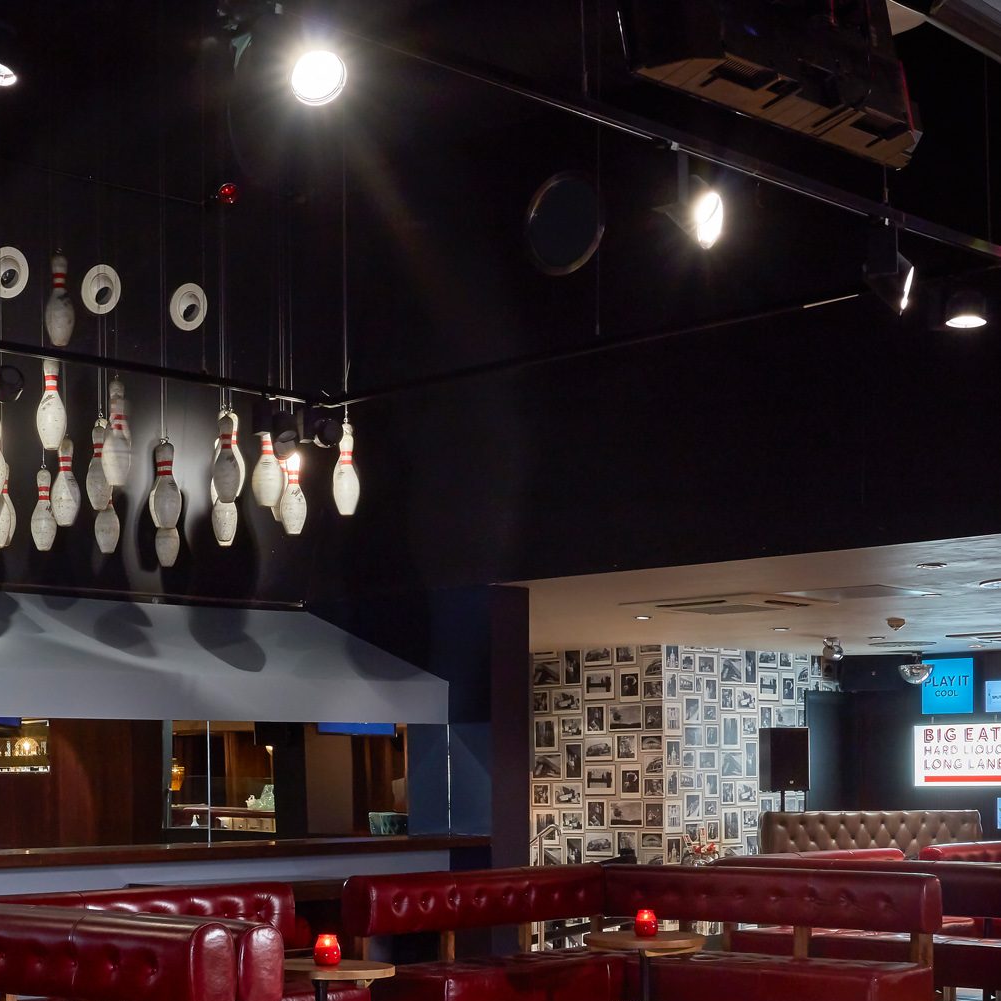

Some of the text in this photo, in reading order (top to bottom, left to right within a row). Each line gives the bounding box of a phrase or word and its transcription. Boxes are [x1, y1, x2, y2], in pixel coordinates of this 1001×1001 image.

[958, 675, 969, 686] IT
[924, 728, 957, 743] BIG
[924, 745, 959, 756] HARD
[924, 758, 963, 770] LONG
